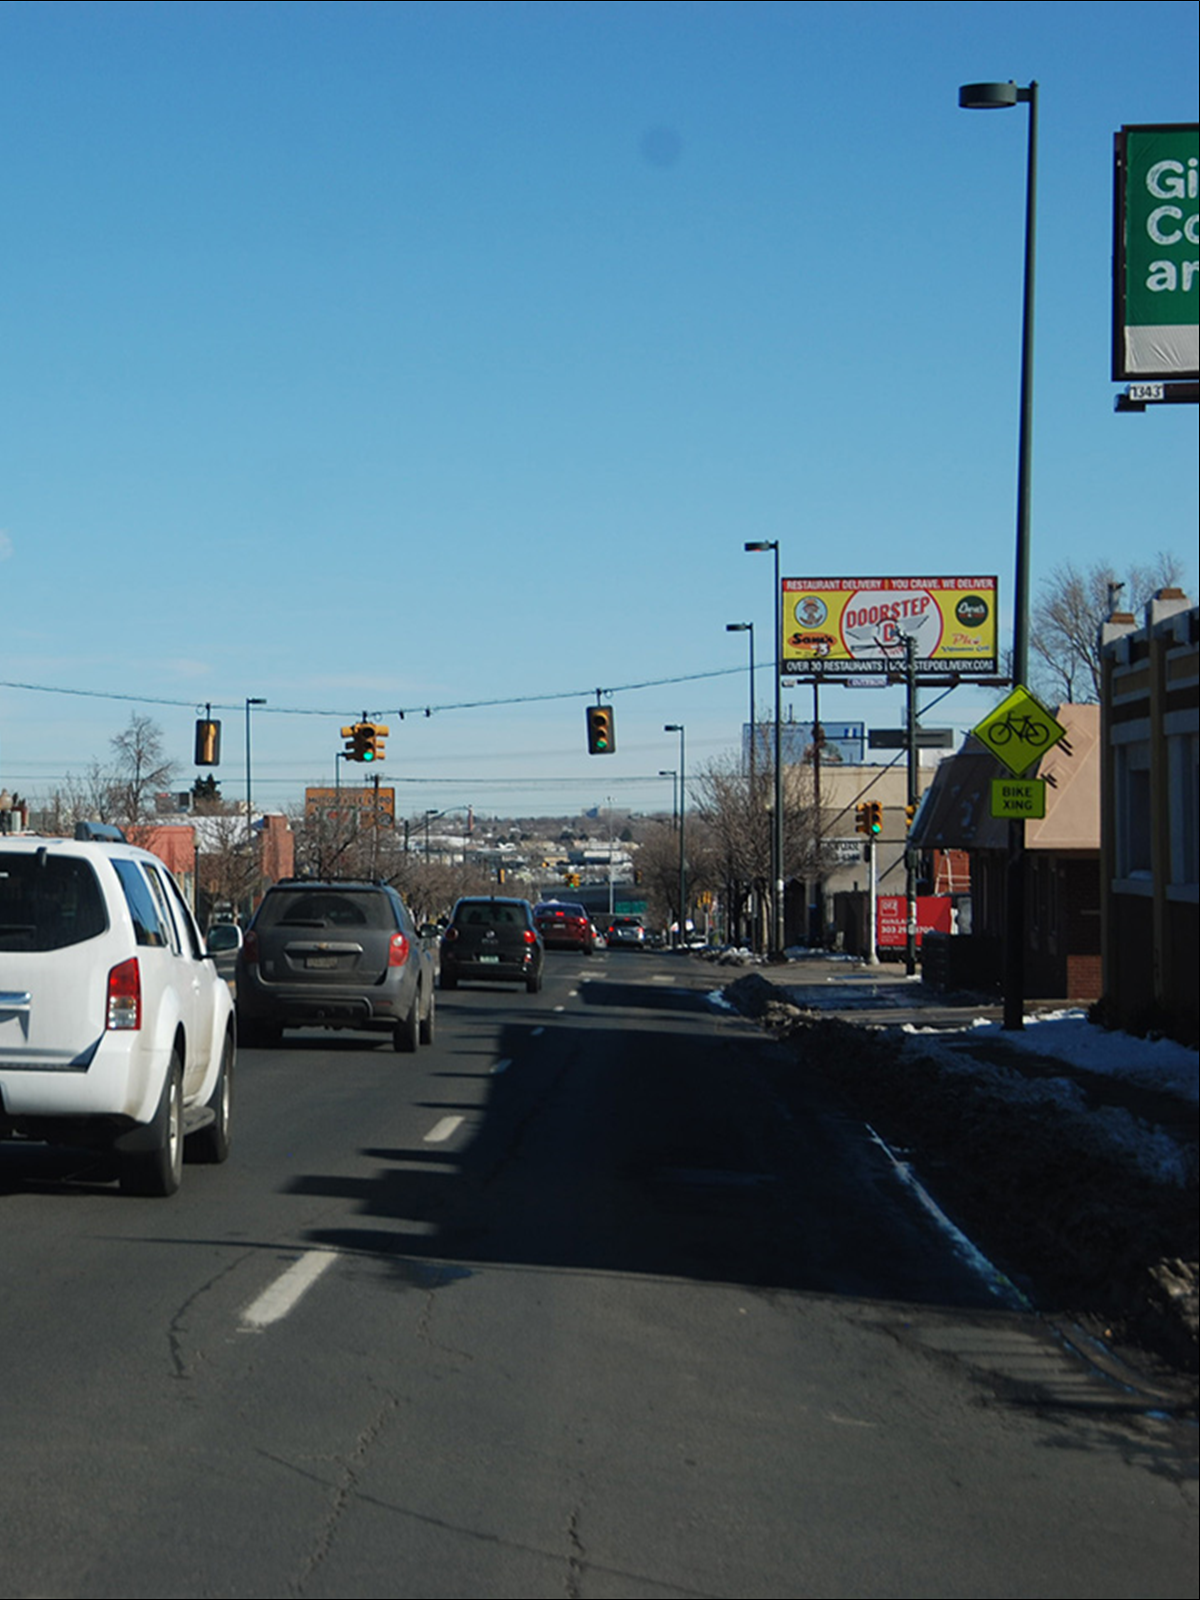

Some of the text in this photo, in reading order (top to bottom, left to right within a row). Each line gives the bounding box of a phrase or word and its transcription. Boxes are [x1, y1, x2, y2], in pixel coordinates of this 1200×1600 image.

[1130, 384, 1162, 398] 1343
[787, 580, 839, 590] RESTAURANT
[842, 580, 881, 590] DELIVERY
[892, 579, 908, 589] YOU
[942, 579, 956, 588] WE
[845, 596, 930, 629] DOORSTEP
[786, 661, 809, 671] OVER
[811, 661, 822, 671] 30
[823, 661, 883, 671] RESTAURANTS
[1002, 786, 1033, 797] BIKE
[1002, 800, 1033, 811] XING
[881, 926, 896, 934] 303
